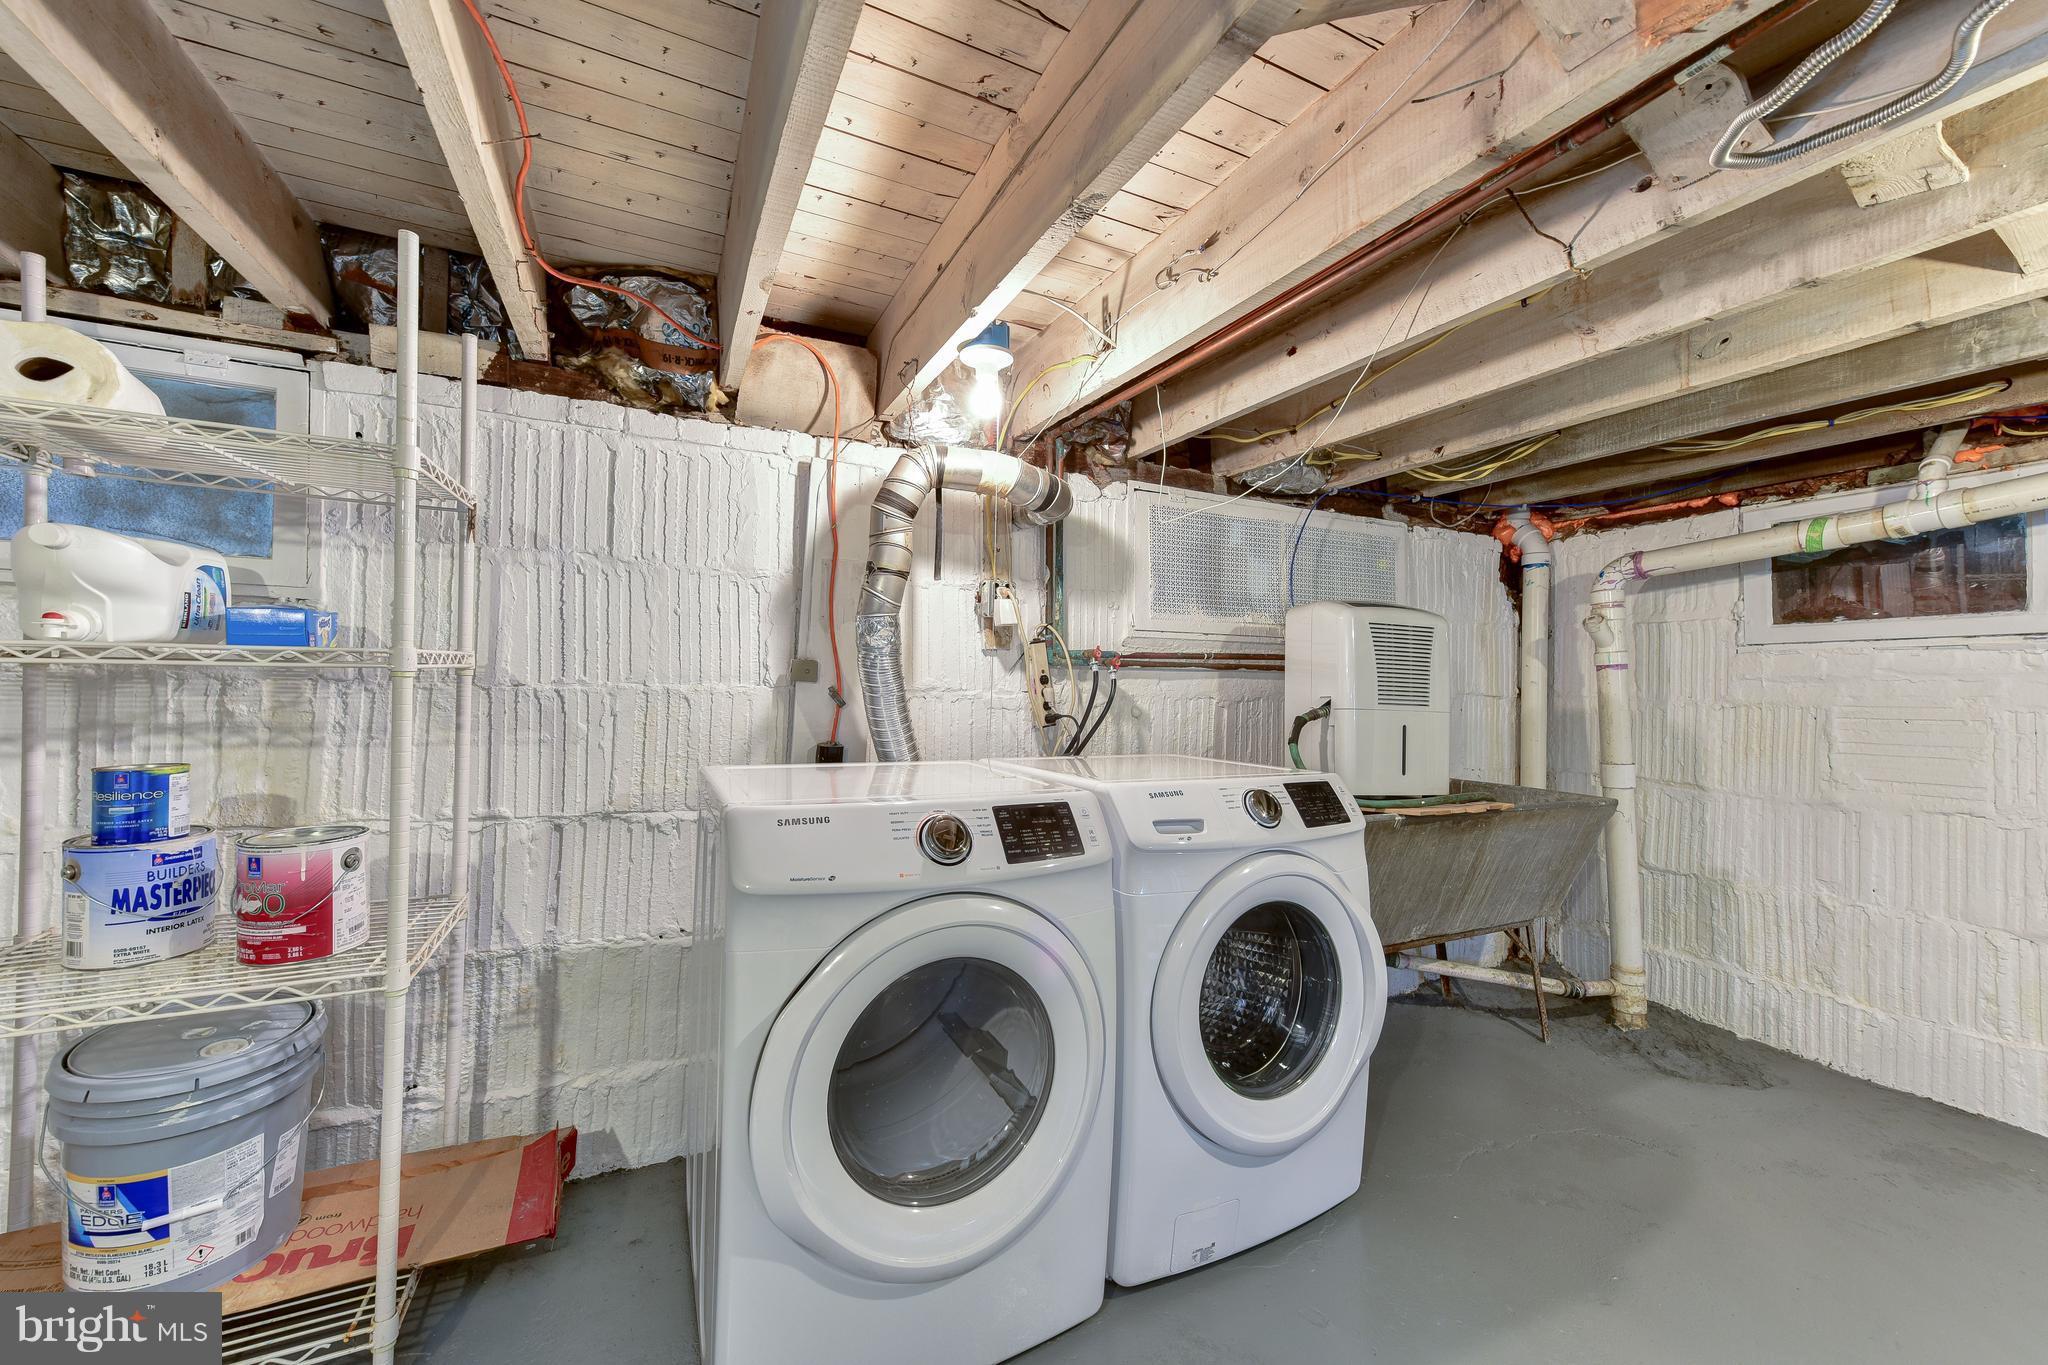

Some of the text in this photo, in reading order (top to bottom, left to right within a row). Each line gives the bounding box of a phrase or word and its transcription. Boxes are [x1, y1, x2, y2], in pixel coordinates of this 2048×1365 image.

[193, 577, 203, 626] Ultra Clean
[92, 790, 164, 801] Resilience
[1148, 790, 1184, 799] SAMSUNG
[777, 816, 831, 827] SAMSUNG
[147, 861, 206, 882] BUILDERS
[146, 916, 205, 935] INTERIOR LATEX
[80, 1211, 143, 1227] EDGE
[315, 1212, 342, 1221] from
[284, 1204, 424, 1248] hadwood
[231, 1224, 416, 1284] Bruc
[144, 1261, 161, 1271] 18.3
[80, 1268, 90, 1276] Net.
[106, 1268, 123, 1276] Cont.
[144, 1267, 162, 1277] 18.3
[102, 1275, 115, 1284] U.S.
[116, 1274, 131, 1283] GAL)
